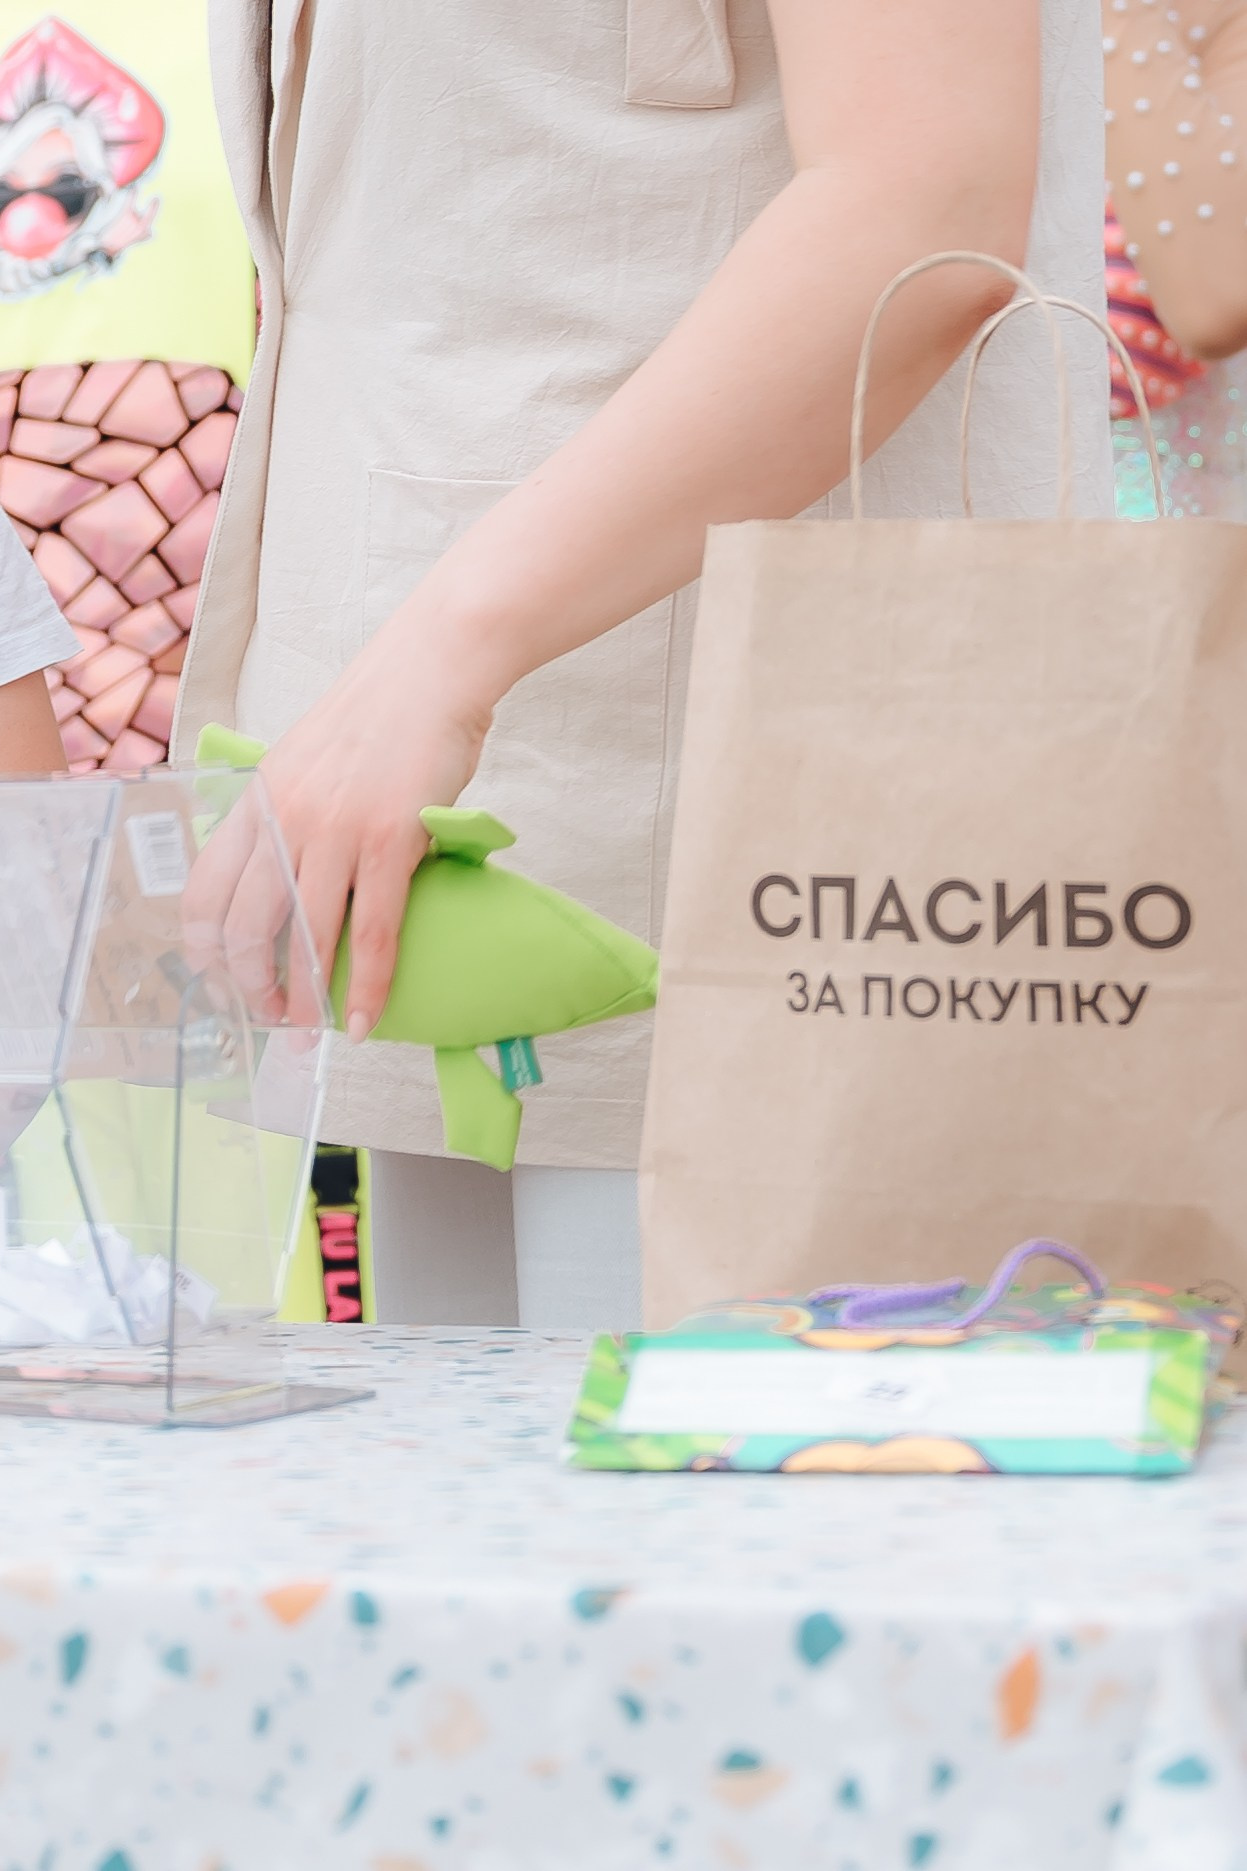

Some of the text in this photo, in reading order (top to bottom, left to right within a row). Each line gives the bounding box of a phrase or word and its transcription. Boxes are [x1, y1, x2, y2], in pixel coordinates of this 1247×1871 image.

[751, 873, 1193, 951] СПАСИБО
[786, 970, 1149, 1026] ЗА ПОКУПКУ
